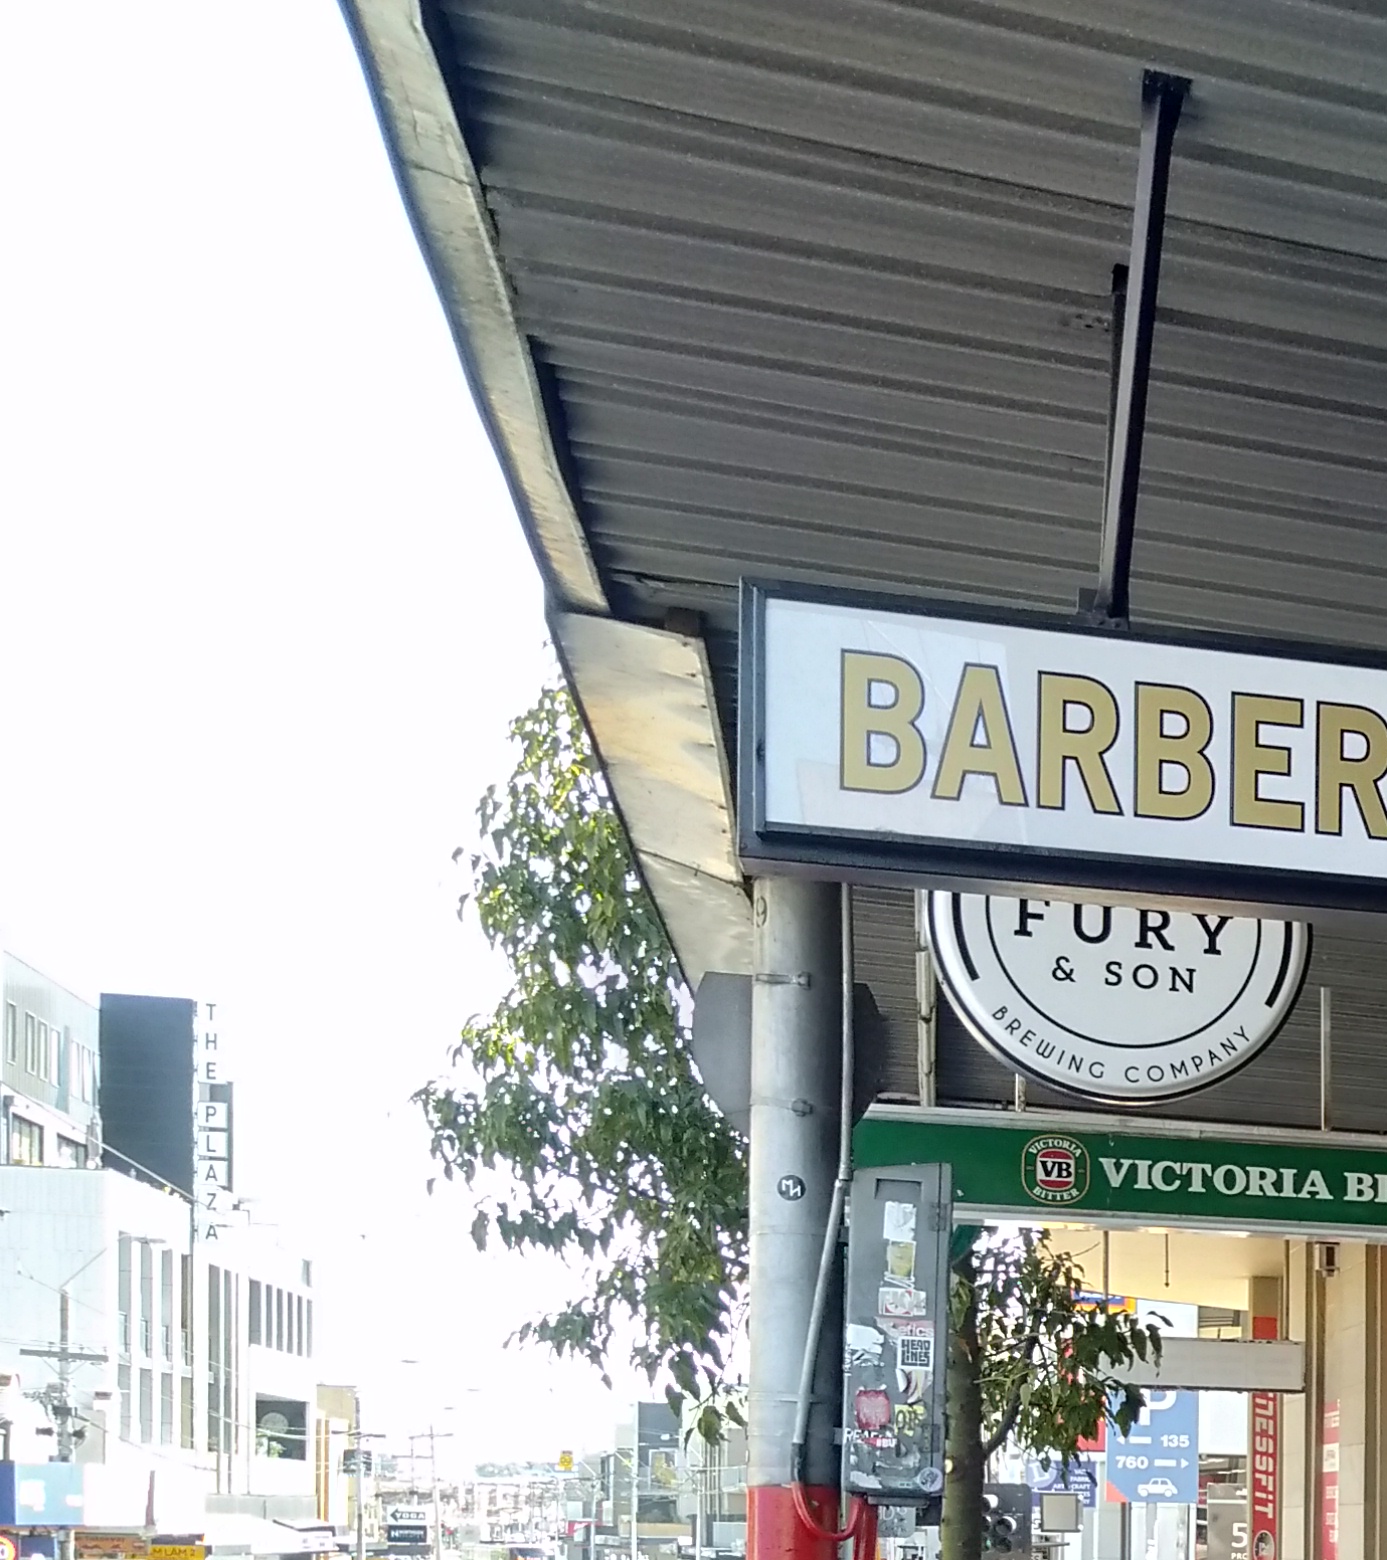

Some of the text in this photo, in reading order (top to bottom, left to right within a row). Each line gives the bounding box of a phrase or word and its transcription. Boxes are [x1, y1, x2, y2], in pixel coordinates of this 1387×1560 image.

[1014, 898, 1233, 956] FURY
[1052, 956, 1196, 993] & SON
[205, 1002, 217, 1081] THE
[992, 1005, 1252, 1084] BREWING COMPANY
[1028, 1138, 1082, 1157] VICTORIA
[204, 1107, 219, 1241] PLAZA
[1038, 1159, 1074, 1179] VB
[1099, 1156, 1334, 1200] VICTORIA
[1032, 1185, 1080, 1201] BITTER
[1160, 1435, 1190, 1448] 135
[1115, 1456, 1149, 1469] 760
[395, 1511, 426, 1520] YOGA
